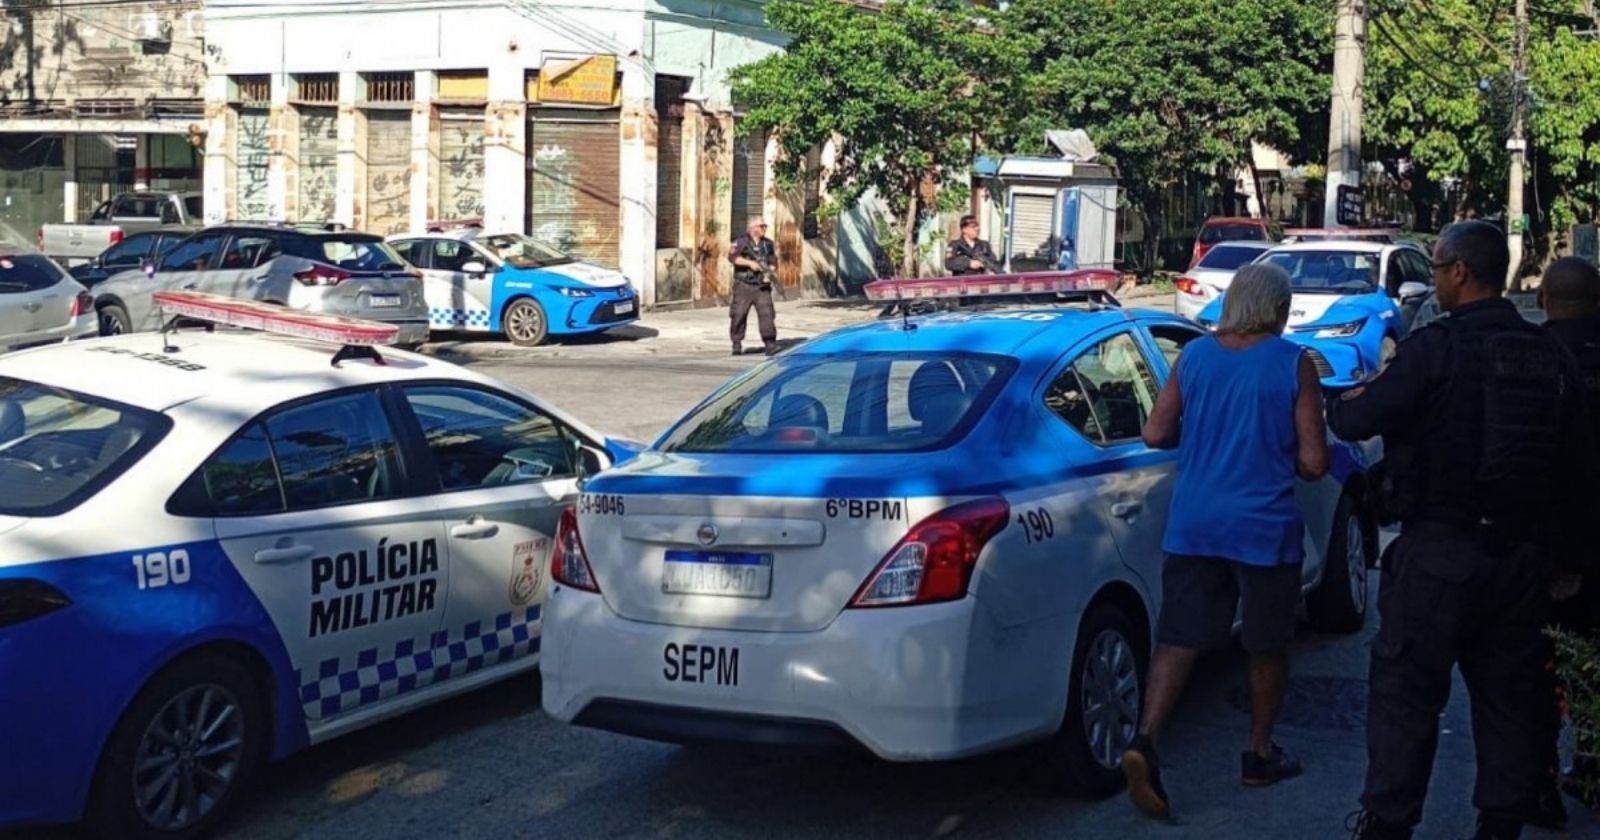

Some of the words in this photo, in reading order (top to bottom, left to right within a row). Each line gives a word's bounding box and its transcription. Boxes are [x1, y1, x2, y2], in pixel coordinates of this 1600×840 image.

[579, 495, 625, 516] 54-9046
[1017, 507, 1053, 544] 190
[132, 549, 191, 589] 190
[311, 537, 439, 594] POLÍCIA
[308, 579, 437, 637] MILITAR
[663, 643, 738, 687] SEPM
